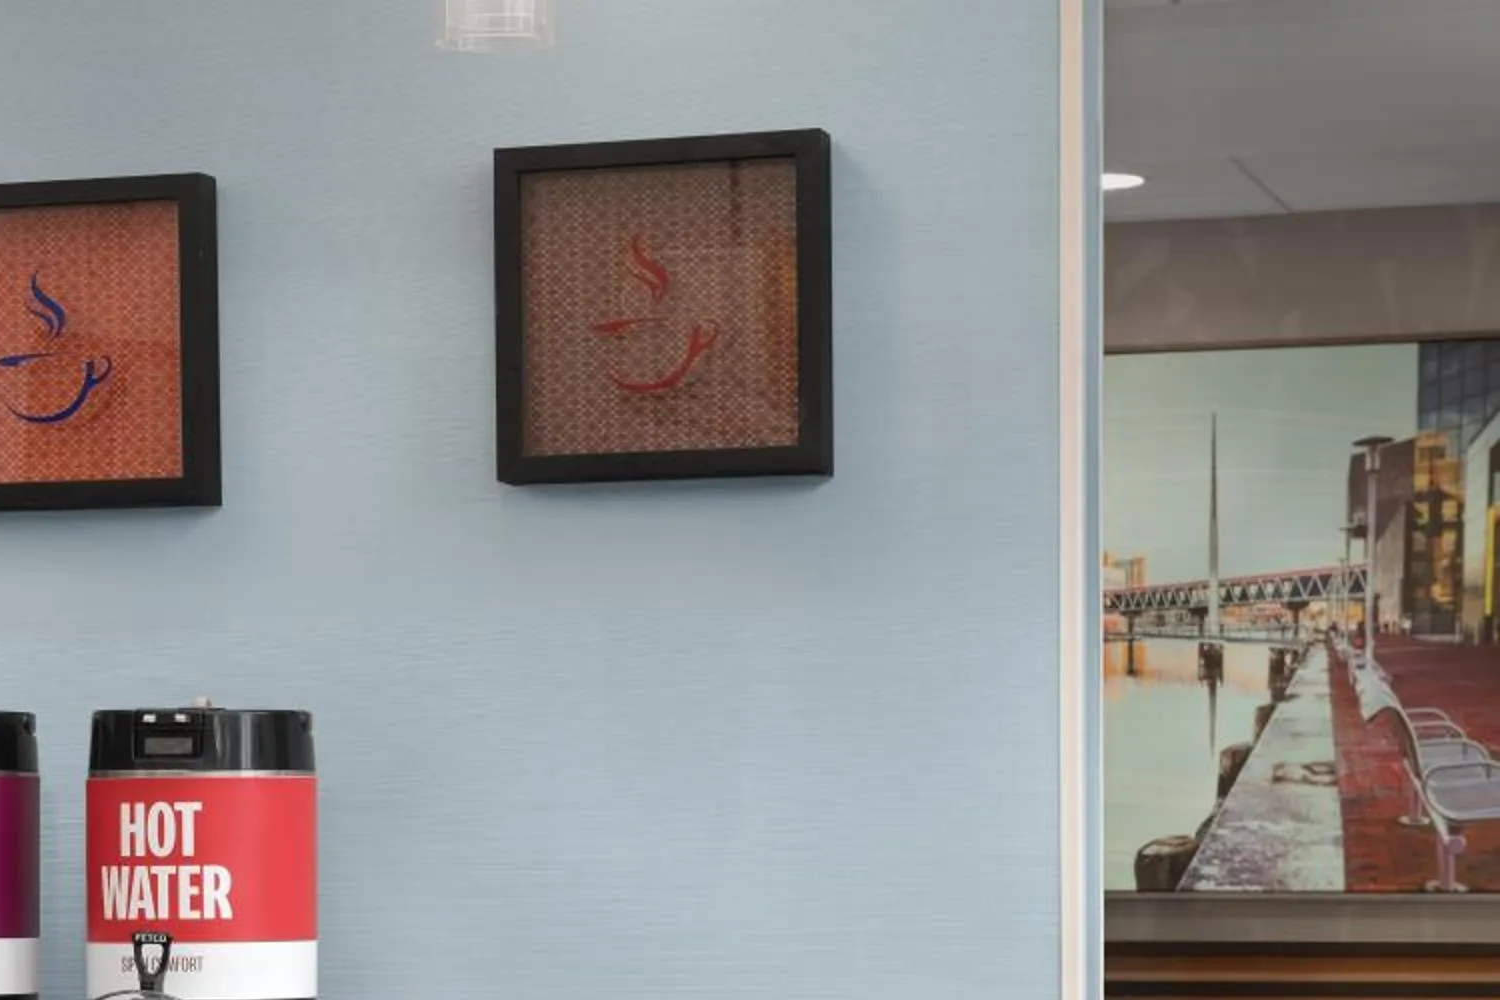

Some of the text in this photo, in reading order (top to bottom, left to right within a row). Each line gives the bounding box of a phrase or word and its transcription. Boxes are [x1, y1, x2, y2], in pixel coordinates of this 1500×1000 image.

[120, 802, 203, 857] HOT
[101, 865, 233, 921] WATER
[135, 933, 167, 942] FETCO
